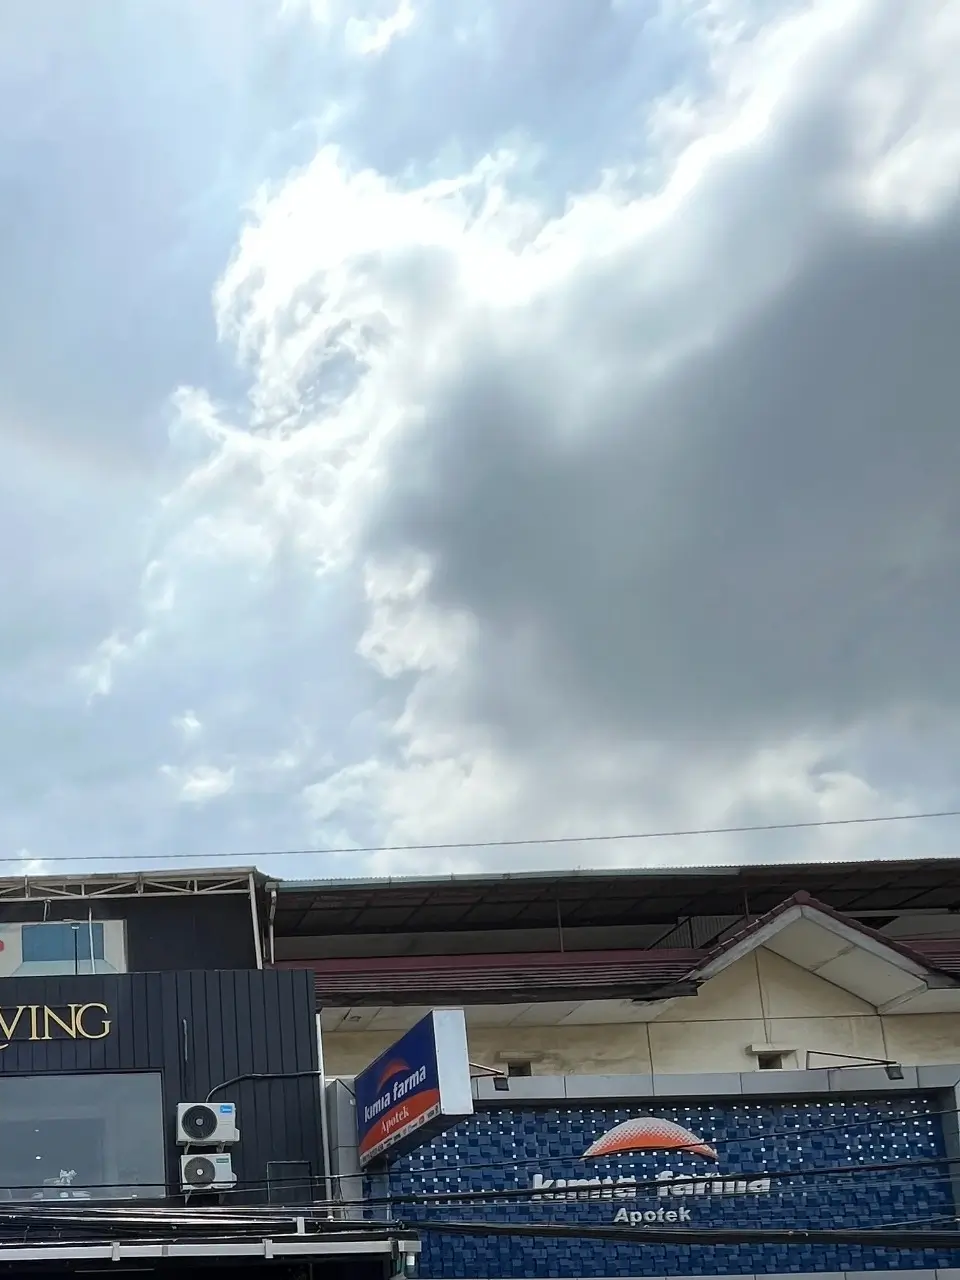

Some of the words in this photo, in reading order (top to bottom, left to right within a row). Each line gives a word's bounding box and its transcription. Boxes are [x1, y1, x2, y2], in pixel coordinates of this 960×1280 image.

[392, 1065, 427, 1101] farma
[381, 1105, 410, 1134] Apotek
[656, 1170, 772, 1198] farma
[613, 1206, 692, 1226] Apotek
